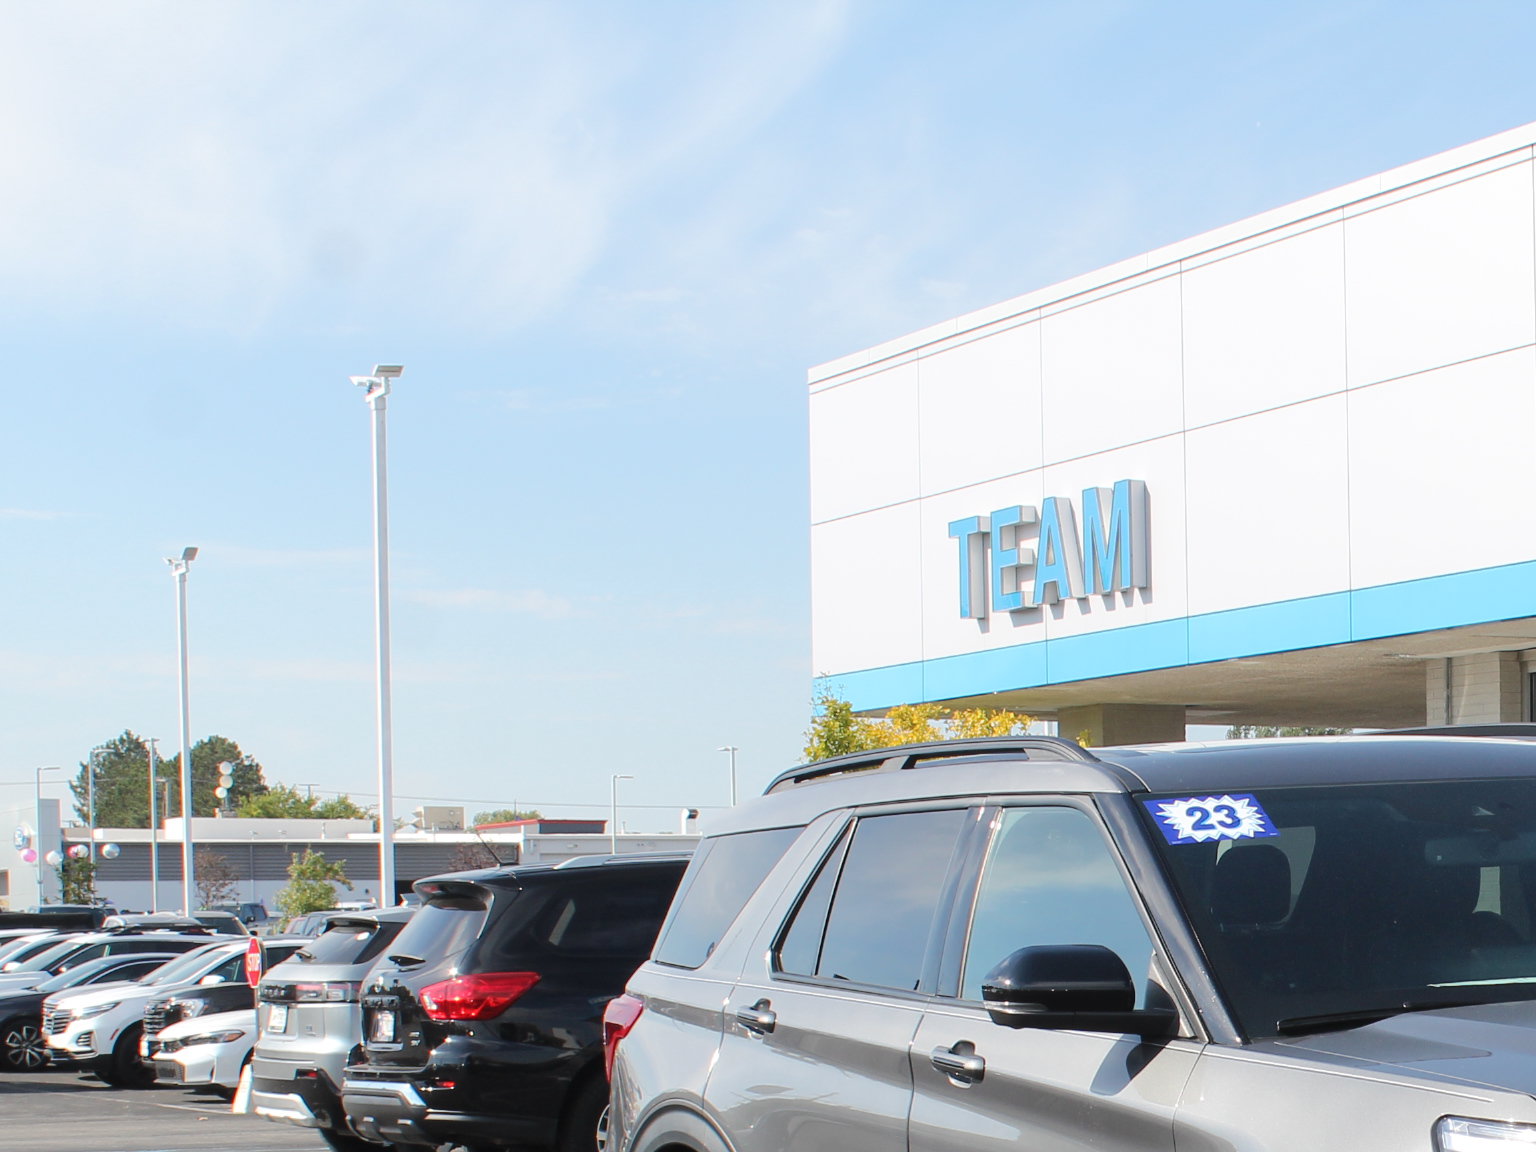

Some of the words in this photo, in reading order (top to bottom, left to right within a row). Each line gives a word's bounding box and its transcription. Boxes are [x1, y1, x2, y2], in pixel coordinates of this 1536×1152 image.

[949, 479, 1146, 620] TEAM
[1185, 804, 1241, 831] 23
[247, 952, 261, 972] STOP
